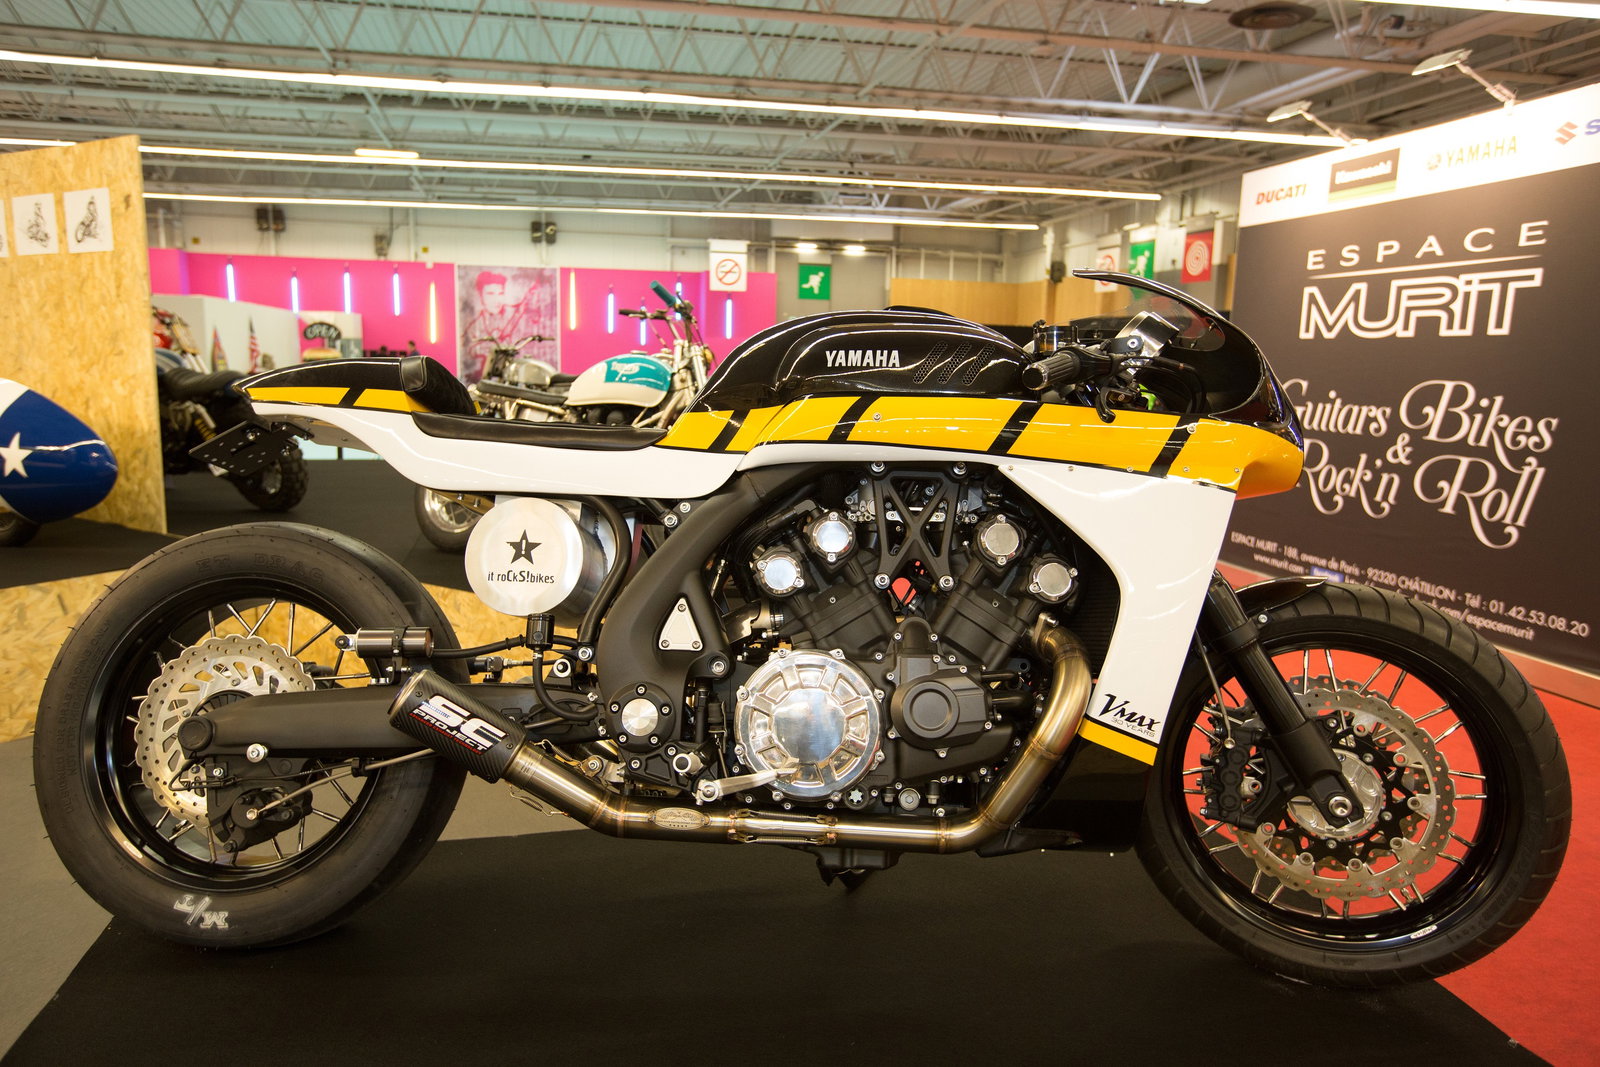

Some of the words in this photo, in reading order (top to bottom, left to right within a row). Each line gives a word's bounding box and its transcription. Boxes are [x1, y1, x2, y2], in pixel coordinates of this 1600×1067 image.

[1447, 136, 1517, 168] YAMAHA
[1256, 183, 1307, 205] DUCATI
[1306, 220, 1549, 271] ESPACE
[304, 322, 340, 339] OPEN
[825, 349, 900, 368] YAMAHA
[1400, 379, 1559, 475] Bikes
[1386, 432, 1412, 466] &
[1413, 454, 1546, 550] Roll
[1230, 531, 1256, 547] ESPACE
[1256, 539, 1279, 554] MURIT
[1300, 552, 1328, 568] avenue
[1327, 556, 1339, 571] de
[1339, 560, 1361, 576] Paris
[1366, 567, 1397, 587] 92320
[487, 571, 495, 582] it
[412, 708, 488, 751] PROJECT
[417, 694, 508, 748] SC
[1111, 716, 1124, 726] 30
[1126, 722, 1156, 738] YEARS
